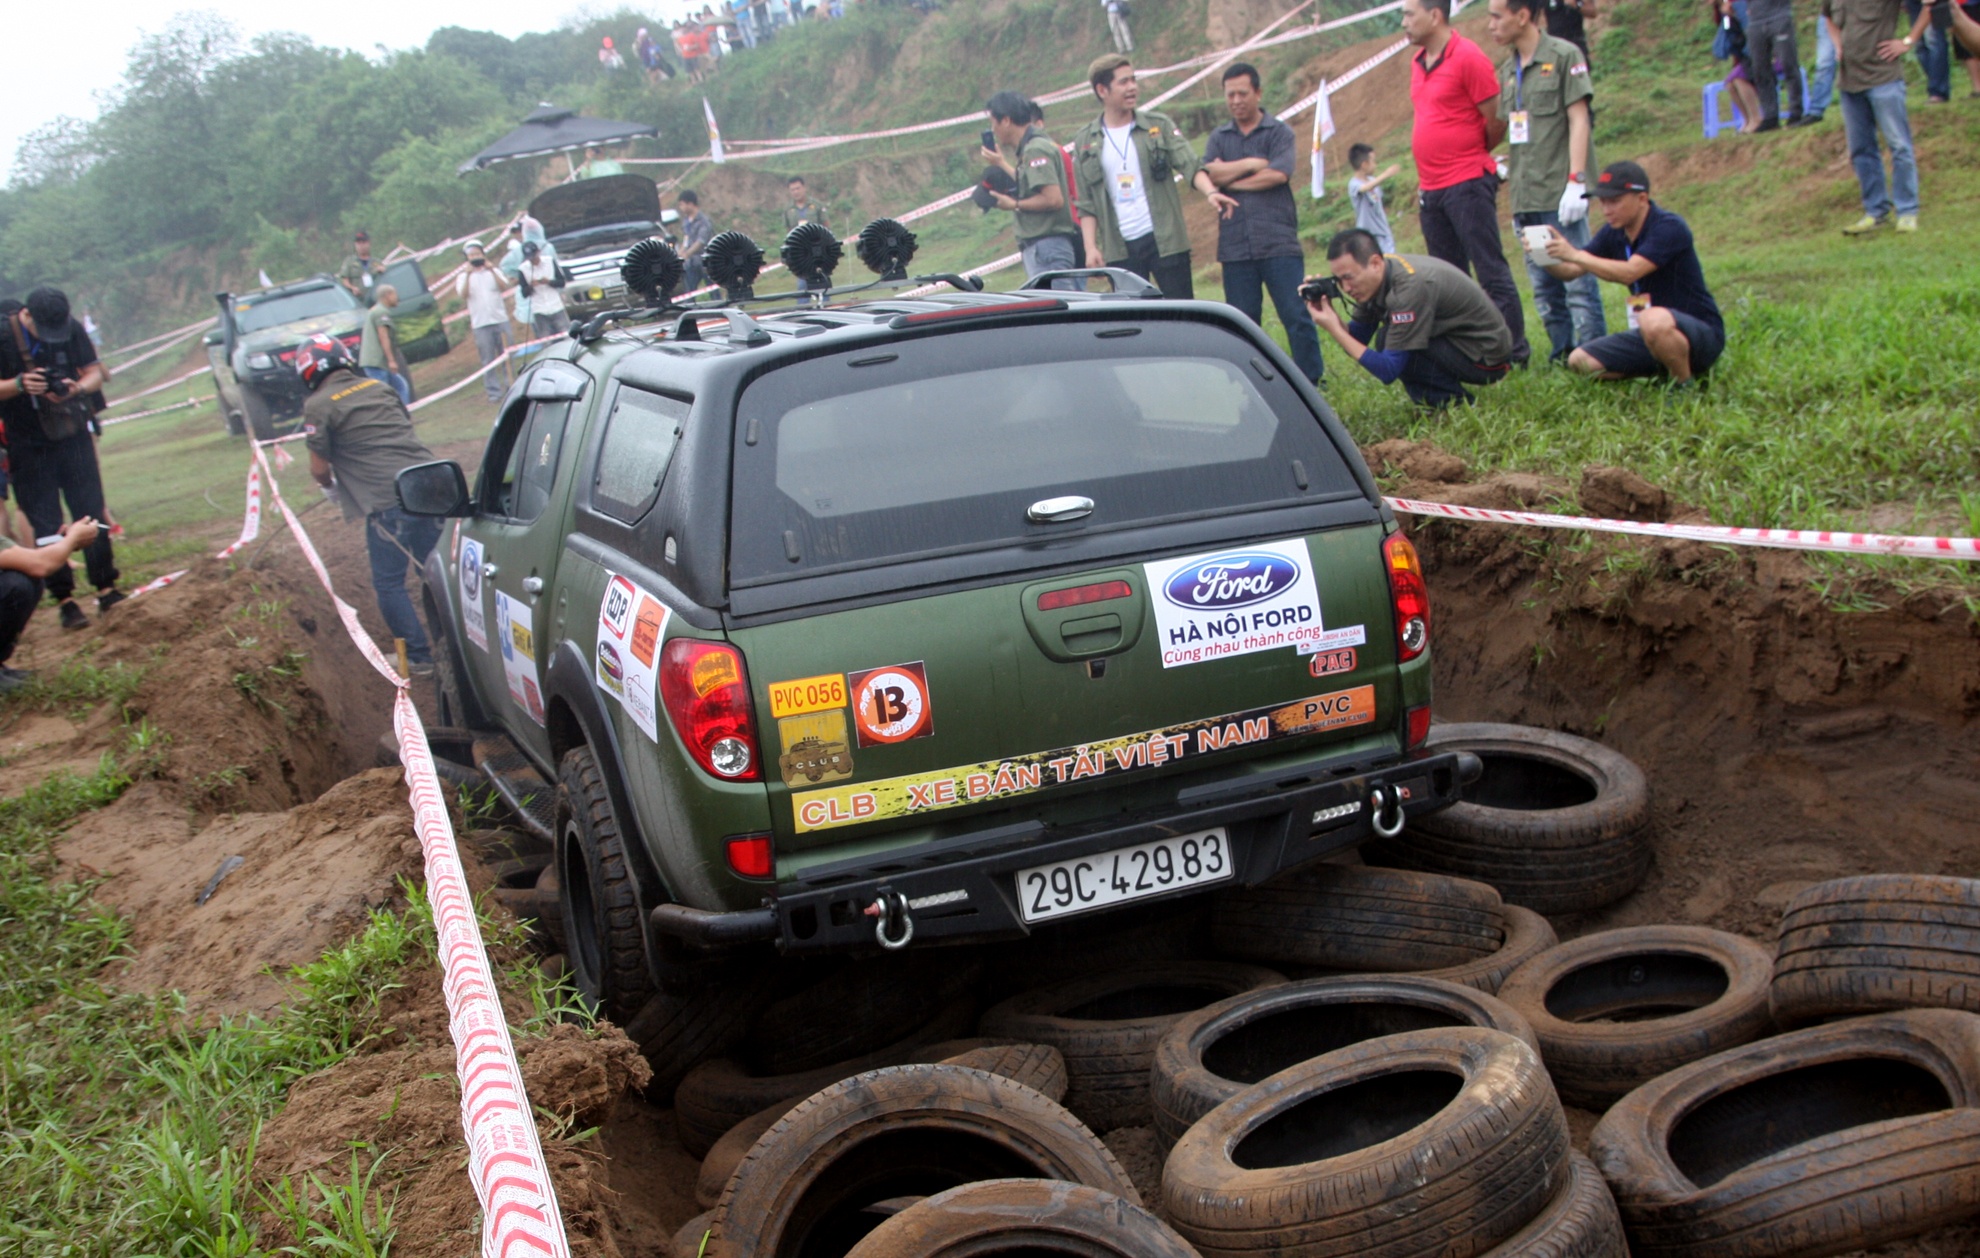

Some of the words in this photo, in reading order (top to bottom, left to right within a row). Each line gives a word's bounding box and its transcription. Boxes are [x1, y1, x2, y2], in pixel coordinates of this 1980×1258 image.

[1193, 560, 1273, 604] Ford
[1170, 620, 1203, 645] HÀ
[1207, 613, 1247, 639] NỘI
[1253, 605, 1312, 630] FORD
[1164, 647, 1201, 664] Cùng
[1205, 641, 1240, 657] nhau
[1244, 631, 1284, 649] thành
[1287, 626, 1320, 641] công
[1315, 651, 1350, 672] PAC
[774, 686, 803, 711] PVC
[806, 681, 842, 706] 056
[874, 686, 908, 725] 13
[1304, 696, 1350, 720] PVC
[796, 756, 841, 769] CLUB
[801, 793, 876, 825] CLB
[907, 780, 956, 810] XE
[967, 764, 1041, 798] BÁN
[1050, 747, 1105, 782] TẢI
[1113, 734, 1188, 767] VIỆT
[1198, 716, 1269, 752] NAM
[1027, 834, 1223, 914] 29C-429.83
